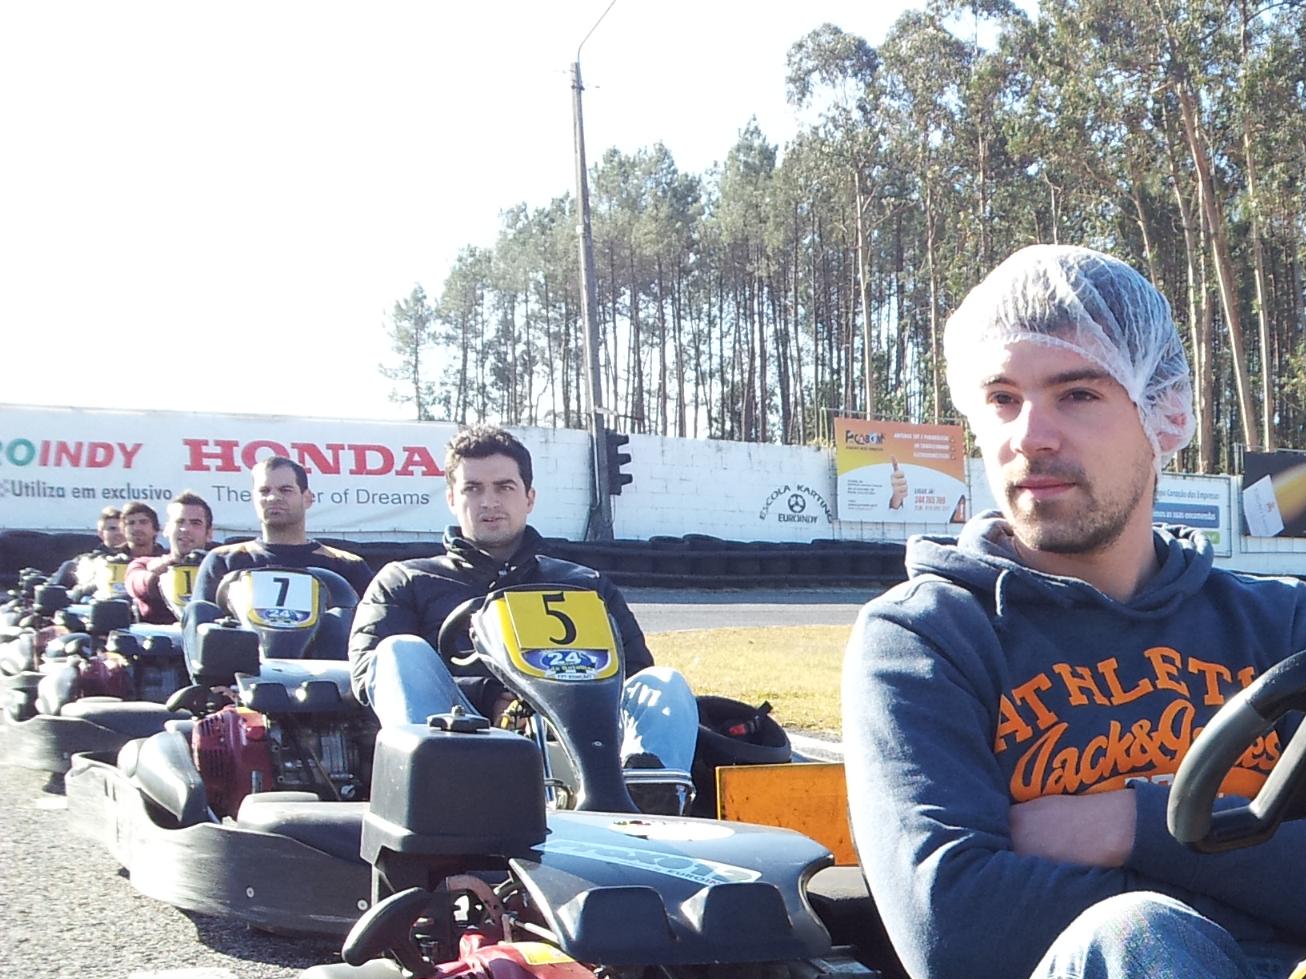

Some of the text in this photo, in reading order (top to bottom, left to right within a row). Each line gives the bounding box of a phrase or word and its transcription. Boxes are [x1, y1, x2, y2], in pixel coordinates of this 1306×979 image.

[0, 438, 144, 469] OINDY
[183, 438, 446, 477] HONDA
[10, 480, 173, 500] Utiliza em exclusivo
[212, 485, 251, 502] The
[331, 488, 350, 504] of
[357, 489, 430, 505] Dreams
[759, 484, 833, 524] ESCOLA KARTING
[778, 513, 818, 523] EUROINDY
[272, 577, 290, 607] 7
[542, 592, 577, 645] 5
[548, 652, 582, 666] 24
